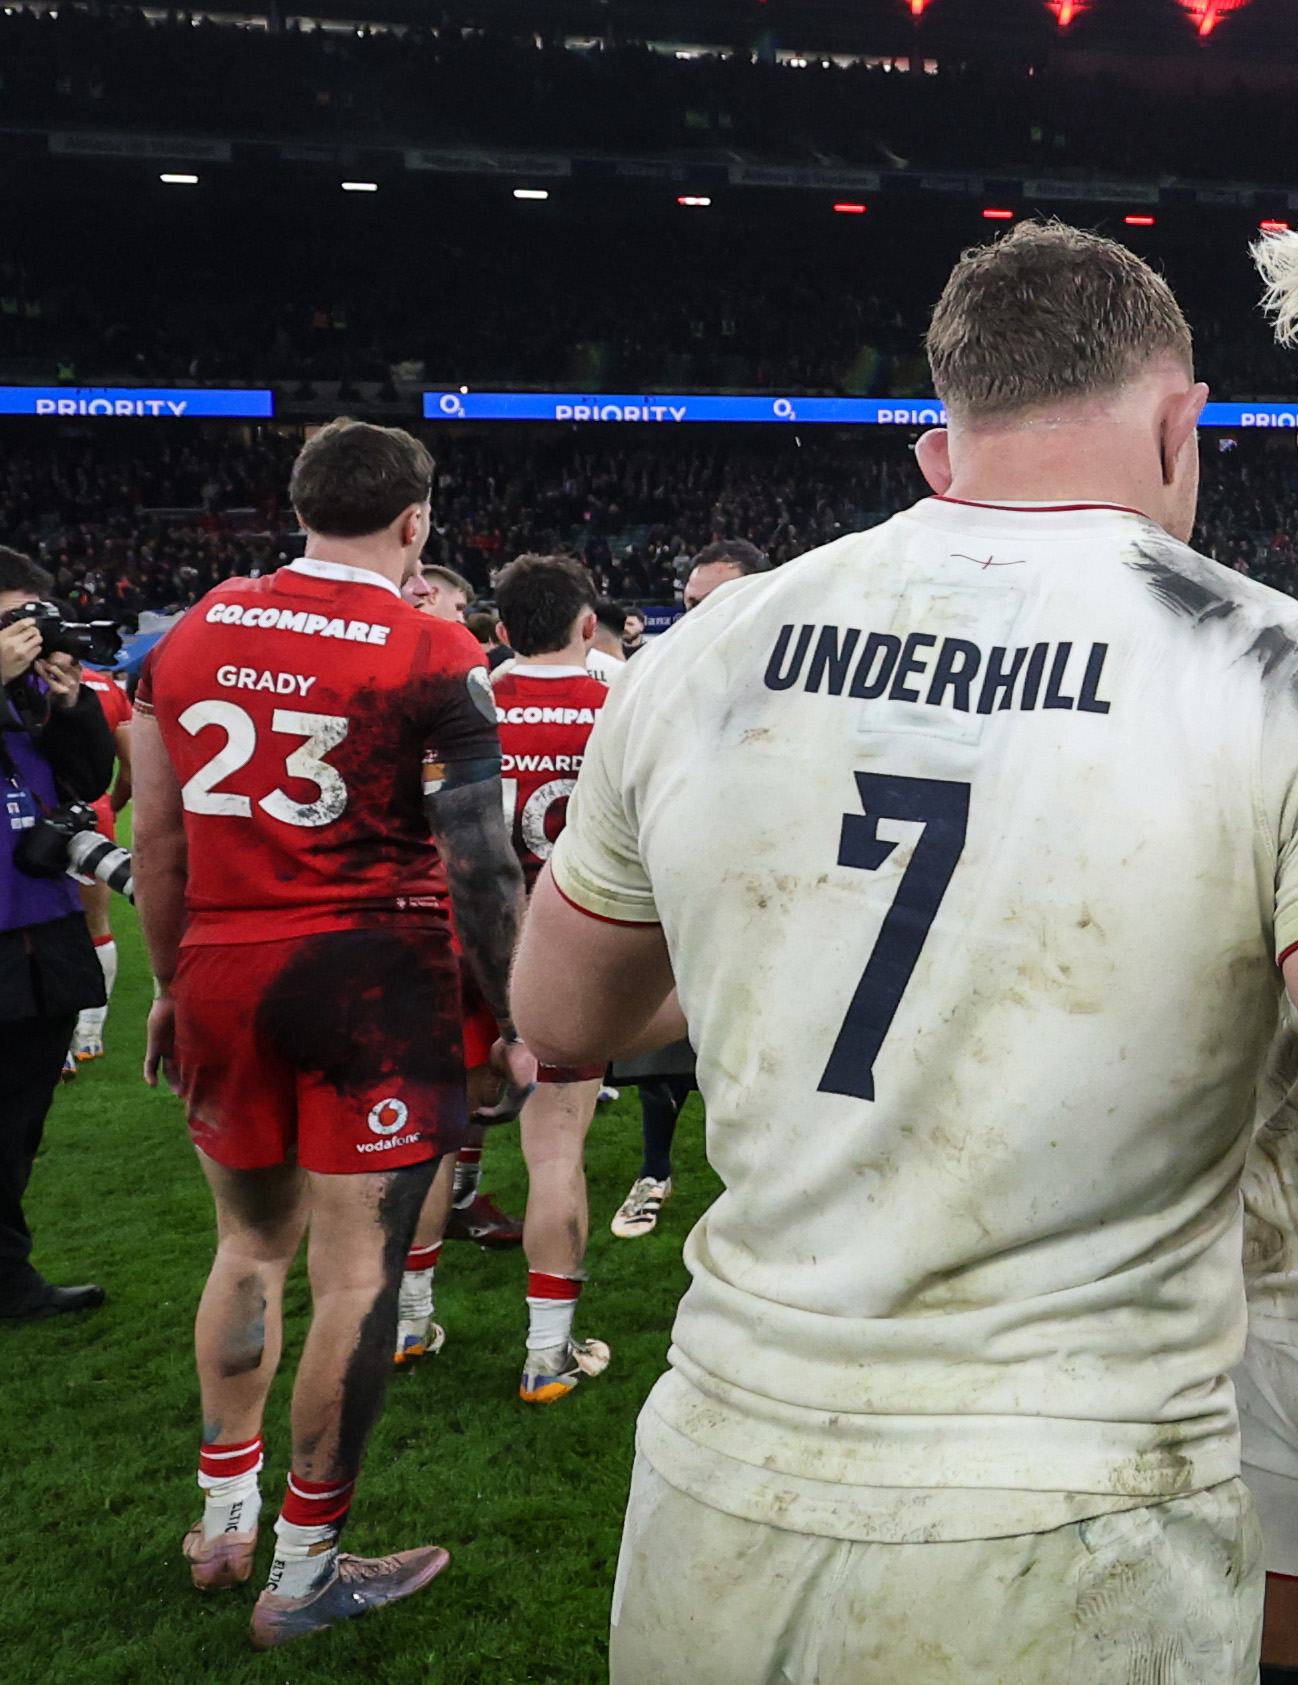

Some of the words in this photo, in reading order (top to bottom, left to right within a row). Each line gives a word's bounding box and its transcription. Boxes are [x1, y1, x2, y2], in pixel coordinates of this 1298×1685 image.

[36, 399, 187, 417] PRIORITY
[555, 405, 687, 422] PRIORITY
[206, 603, 390, 645] GO.COMPARE
[216, 665, 316, 697] GRADY
[763, 624, 1111, 714] UNDERHILL
[177, 699, 350, 828] 23
[816, 770, 971, 1102] 7
